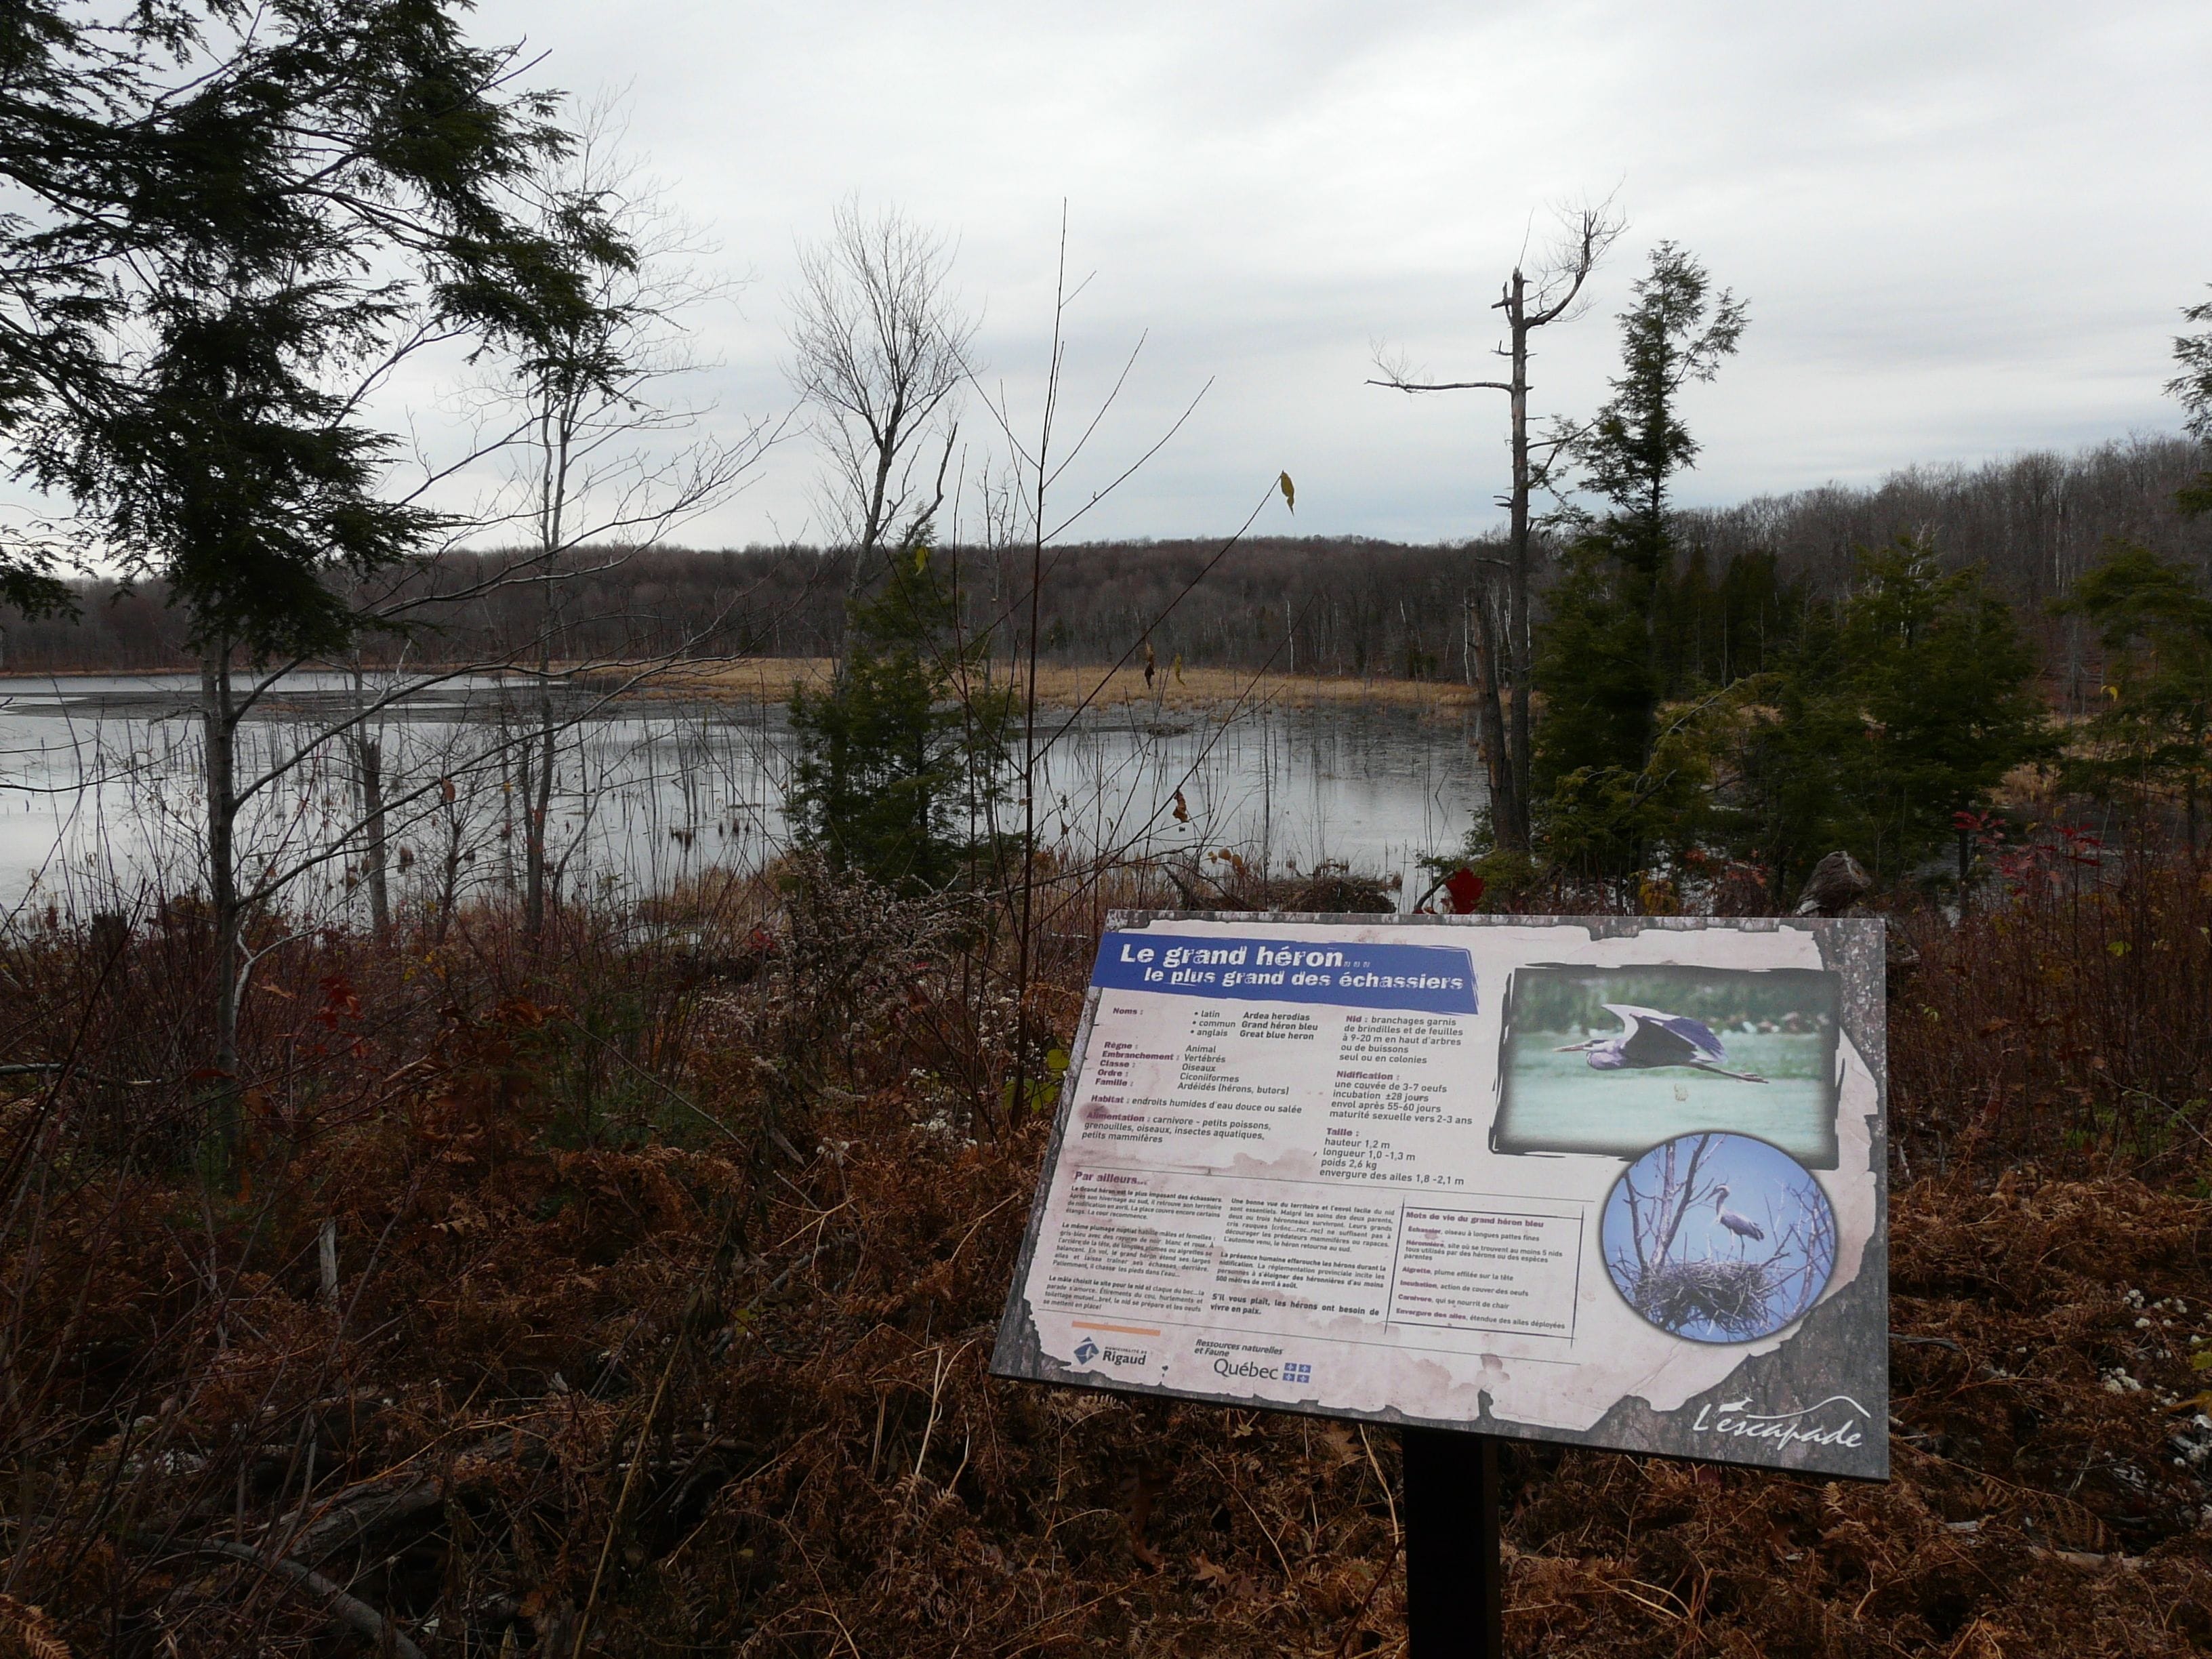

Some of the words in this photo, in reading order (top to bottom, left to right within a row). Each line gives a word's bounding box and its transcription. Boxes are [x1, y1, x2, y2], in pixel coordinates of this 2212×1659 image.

[1120, 943, 1155, 963] Le
[1162, 945, 1248, 969] grand
[1144, 965, 1166, 982] le
[1170, 966, 1216, 987] plus
[1221, 970, 1285, 987] grand
[1291, 970, 1331, 986] des
[1338, 971, 1463, 989] échassiers
[1112, 1007, 1138, 1015] Noms
[1200, 1010, 1221, 1018] latin
[1242, 1011, 1269, 1020] Ardea
[1271, 1012, 1310, 1021] herodias
[1241, 1020, 1269, 1029] Grand
[1270, 1021, 1296, 1030] héron
[1298, 1022, 1318, 1031] bleu
[1345, 1015, 1363, 1023] Nid
[1371, 1015, 1425, 1027] branchages
[1427, 1018, 1456, 1027] garnis
[1196, 1029, 1228, 1038] anglais
[1240, 1029, 1265, 1038] Great
[1265, 1030, 1286, 1039] blue
[1288, 1031, 1314, 1040] heron
[1344, 1024, 1355, 1032] de
[1357, 1024, 1401, 1034] brindilles
[1414, 1027, 1427, 1035] de
[1429, 1027, 1463, 1036] feuilles
[1342, 1033, 1349, 1042] à
[1350, 1033, 1372, 1042] 9-20
[1398, 1036, 1420, 1044] haut
[1185, 1044, 1216, 1053] Animal
[1354, 1044, 1366, 1052] de
[1368, 1044, 1409, 1054] buissons
[1101, 1050, 1174, 1061] Embranchement
[1184, 1053, 1226, 1063] Vertébrés
[1338, 1052, 1359, 1061] seul
[1389, 1054, 1427, 1064] colonies
[1099, 1059, 1130, 1068] Classe
[1181, 1063, 1216, 1072] Oiseaux
[1097, 1068, 1123, 1077] Ordre
[1179, 1072, 1240, 1083] Ciconiiformes
[1336, 1070, 1393, 1080] Nidification
[1094, 1078, 1128, 1086] Famille
[1176, 1082, 1216, 1091] Ardéidés
[1353, 1081, 1387, 1090] couvée
[1388, 1082, 1401, 1091] de
[1402, 1082, 1419, 1092] 3-7
[1420, 1084, 1448, 1093] oeufs
[1332, 1089, 1381, 1100] incubation
[1404, 1092, 1429, 1103] jours
[1090, 1094, 1124, 1104] Habitat
[1131, 1097, 1168, 1106] endroits
[1169, 1098, 1207, 1109] humides
[1235, 1102, 1263, 1111] douce
[1277, 1105, 1303, 1114] salée
[1331, 1100, 1356, 1109] envol
[1357, 1101, 1385, 1111] après
[1387, 1101, 1415, 1111] 55-60
[1416, 1103, 1441, 1114] jours
[1086, 1111, 1145, 1122] Alimentation
[1152, 1115, 1193, 1126] carnivore
[1202, 1119, 1228, 1128] petits
[1329, 1110, 1370, 1120] maturité
[1372, 1112, 1412, 1122] sexuelle
[1436, 1114, 1453, 1124] 2-3
[1084, 1122, 1134, 1133] grenouilles,
[1136, 1124, 1172, 1135] oiseaux,
[1174, 1126, 1211, 1136] insectes
[1326, 1127, 1353, 1136] Taille
[1081, 1130, 1106, 1140] petits
[1108, 1133, 1163, 1143] mammifères
[1324, 1136, 1362, 1147] hauteur
[1365, 1139, 1379, 1149] 1,2
[1323, 1147, 1366, 1159] longueur
[1369, 1149, 1382, 1160] 1,0
[1320, 1158, 1347, 1168] poids
[1348, 1159, 1363, 1169] 2,6
[1365, 1160, 1378, 1171] kg
[1073, 1170, 1094, 1181] Par
[1319, 1169, 1368, 1180] envergure
[1370, 1170, 1387, 1181] des
[1389, 1172, 1413, 1182] ailes
[1416, 1174, 1431, 1185] 1,8
[1406, 1211, 1427, 1219] Mots
[1442, 1214, 1456, 1222] vie
[1470, 1216, 1496, 1225] grand
[1496, 1217, 1523, 1227] héron
[1525, 1219, 1544, 1228] bleu
[1229, 1252, 1258, 1261] présence
[1258, 1254, 1286, 1263] humaine
[1287, 1257, 1322, 1267] effarouche
[1333, 1261, 1356, 1269] hérons
[1356, 1263, 1378, 1271] durant
[1433, 1269, 1455, 1277] plume
[1210, 1303, 1230, 1312] vivre
[1242, 1307, 1262, 1315] paix.
[1274, 1298, 1287, 1307] les
[1290, 1300, 1318, 1311] hérons
[1338, 1305, 1366, 1315] besoin
[1369, 1308, 1380, 1316] de
[1193, 1345, 1204, 1355] et
[1204, 1347, 1230, 1357] Faune
[1195, 1338, 1241, 1351] Ressources
[1241, 1345, 1284, 1355] naturelles
[1102, 1350, 1147, 1366] Rigaud
[1213, 1358, 1279, 1380] Québec
